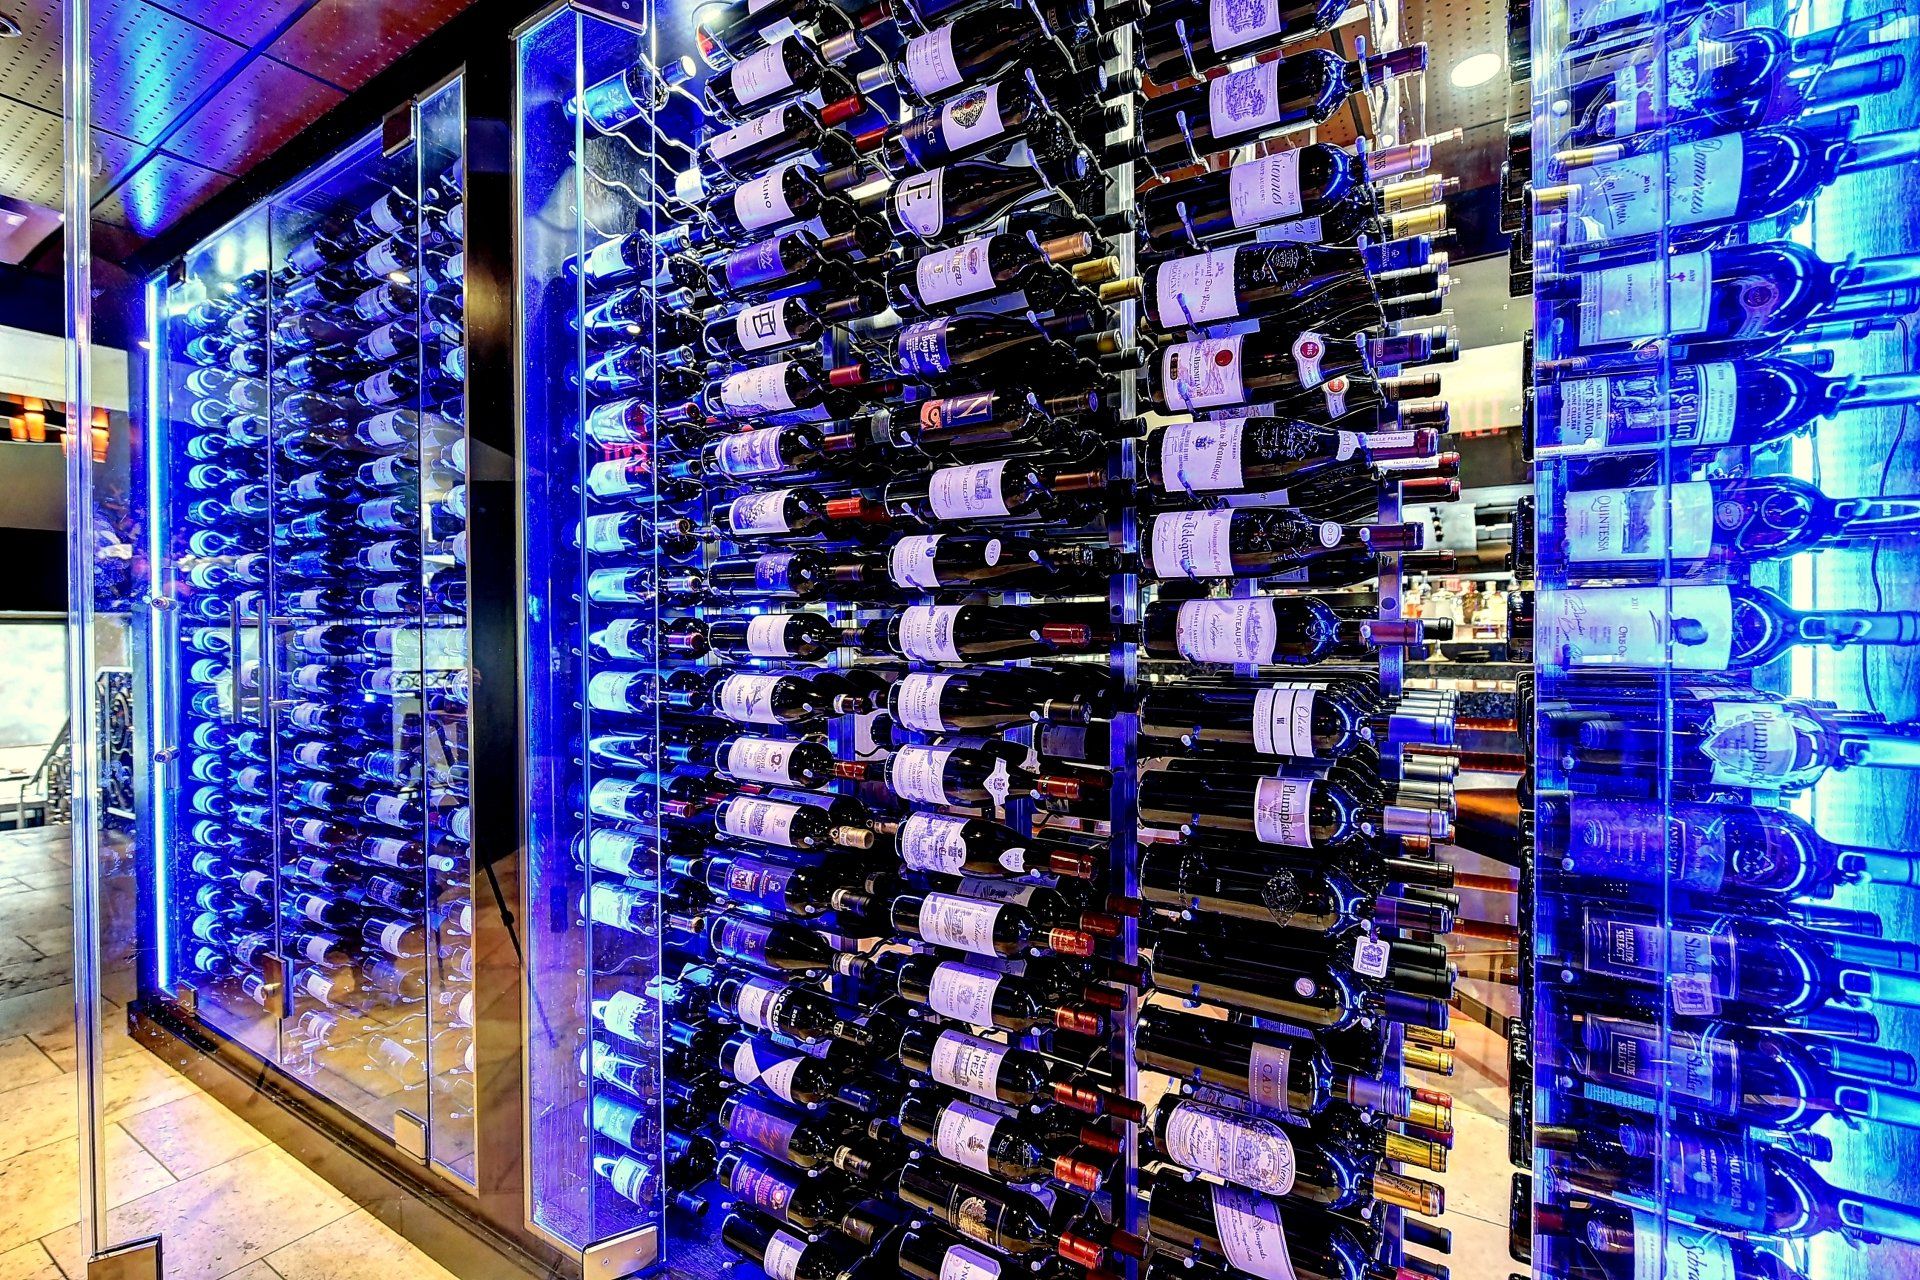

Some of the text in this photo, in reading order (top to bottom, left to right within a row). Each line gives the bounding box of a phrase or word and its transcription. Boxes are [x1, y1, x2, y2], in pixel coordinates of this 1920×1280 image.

[1689, 139, 1723, 216] Dominus
[1590, 495, 1612, 552] QUINTESSA
[1233, 604, 1246, 659] CHATEAU JEAN
[1618, 626, 1629, 645] OPUS
[1747, 710, 1775, 784] PlumpJack
[1279, 784, 1298, 841] PlumpJack
[1615, 929, 1626, 959] SELECT
[1623, 927, 1635, 963] HILLSIDE
[1684, 935, 1703, 977] Shafer
[969, 1054, 982, 1078] PEZ
[1616, 1042, 1627, 1072] SELECT
[1625, 1041, 1637, 1076] HILLSIDE
